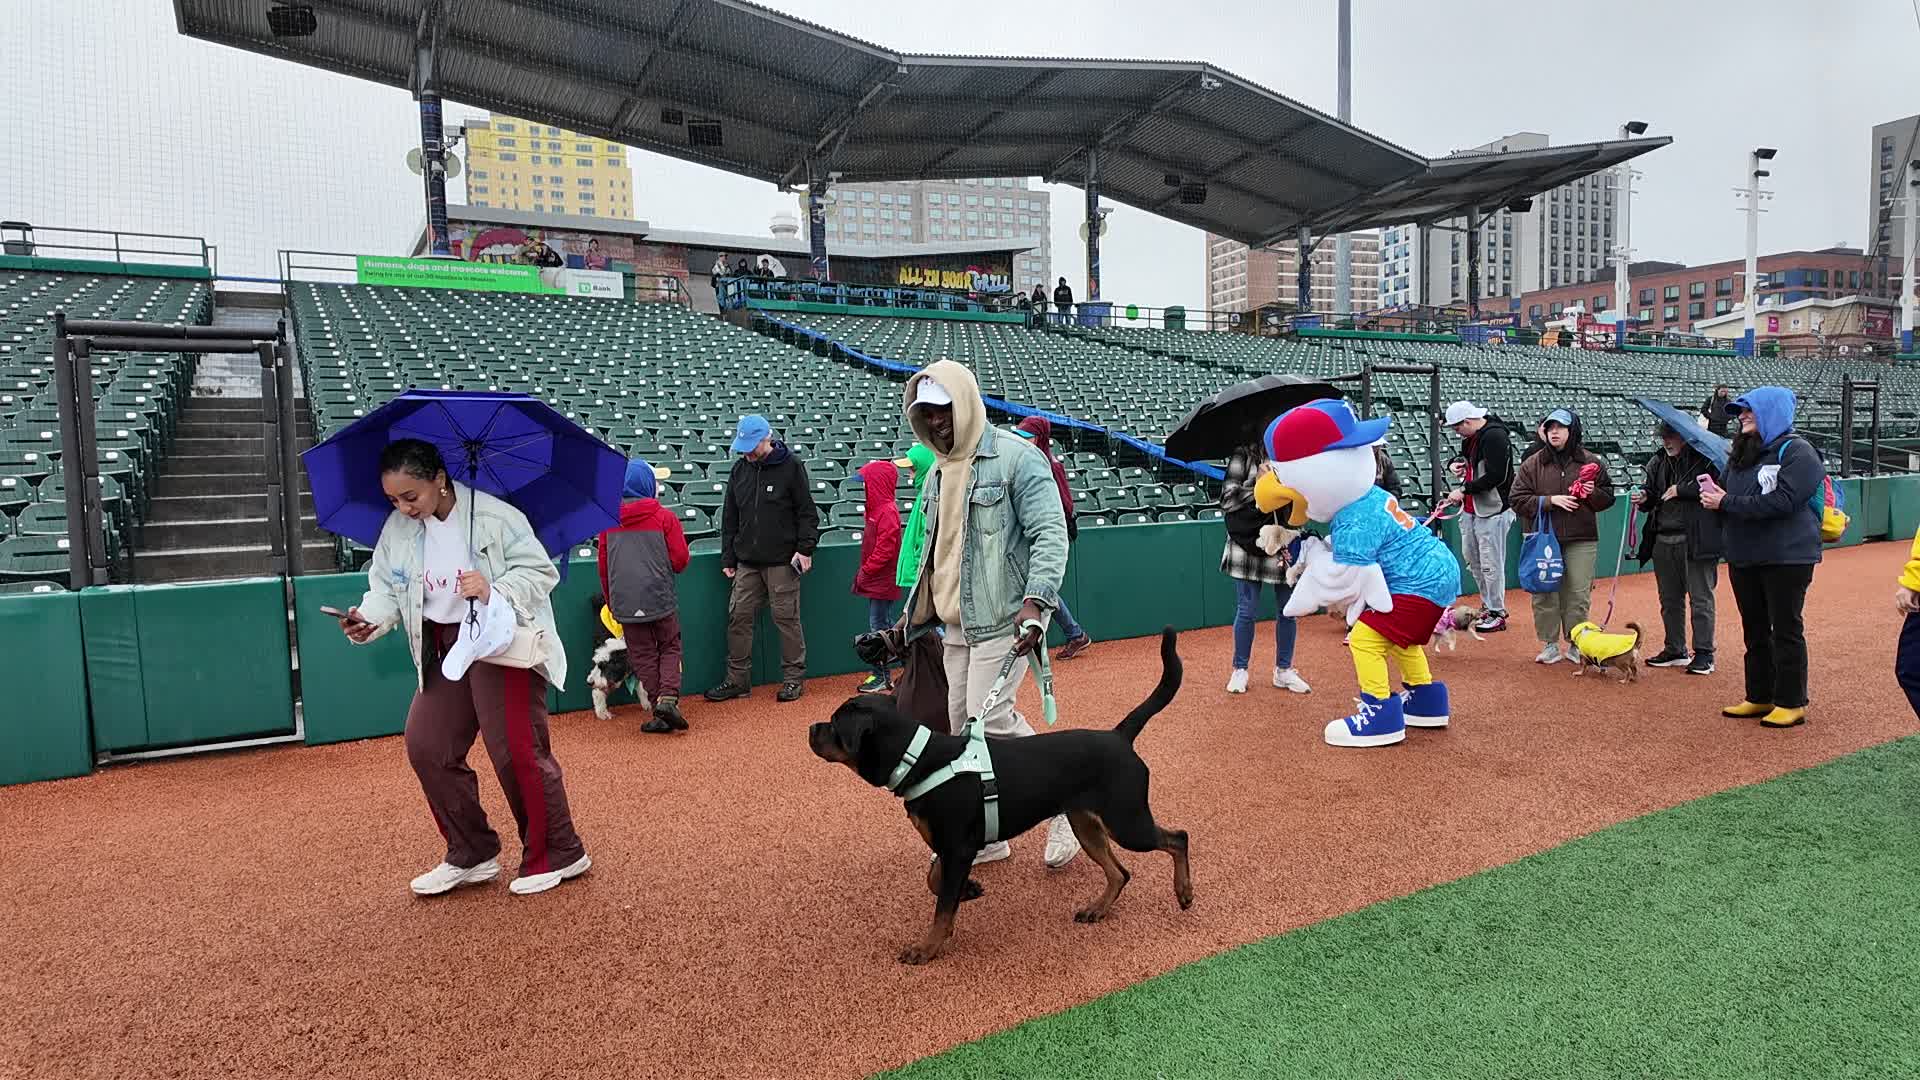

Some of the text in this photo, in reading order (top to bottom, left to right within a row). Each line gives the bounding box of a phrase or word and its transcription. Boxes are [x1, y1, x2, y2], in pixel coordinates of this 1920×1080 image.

[363, 260, 406, 271] Humans,
[407, 262, 430, 273] dogs
[431, 264, 449, 272] and
[450, 265, 489, 275] mascots
[900, 267, 1010, 293] ALL IN YOUR GRILL
